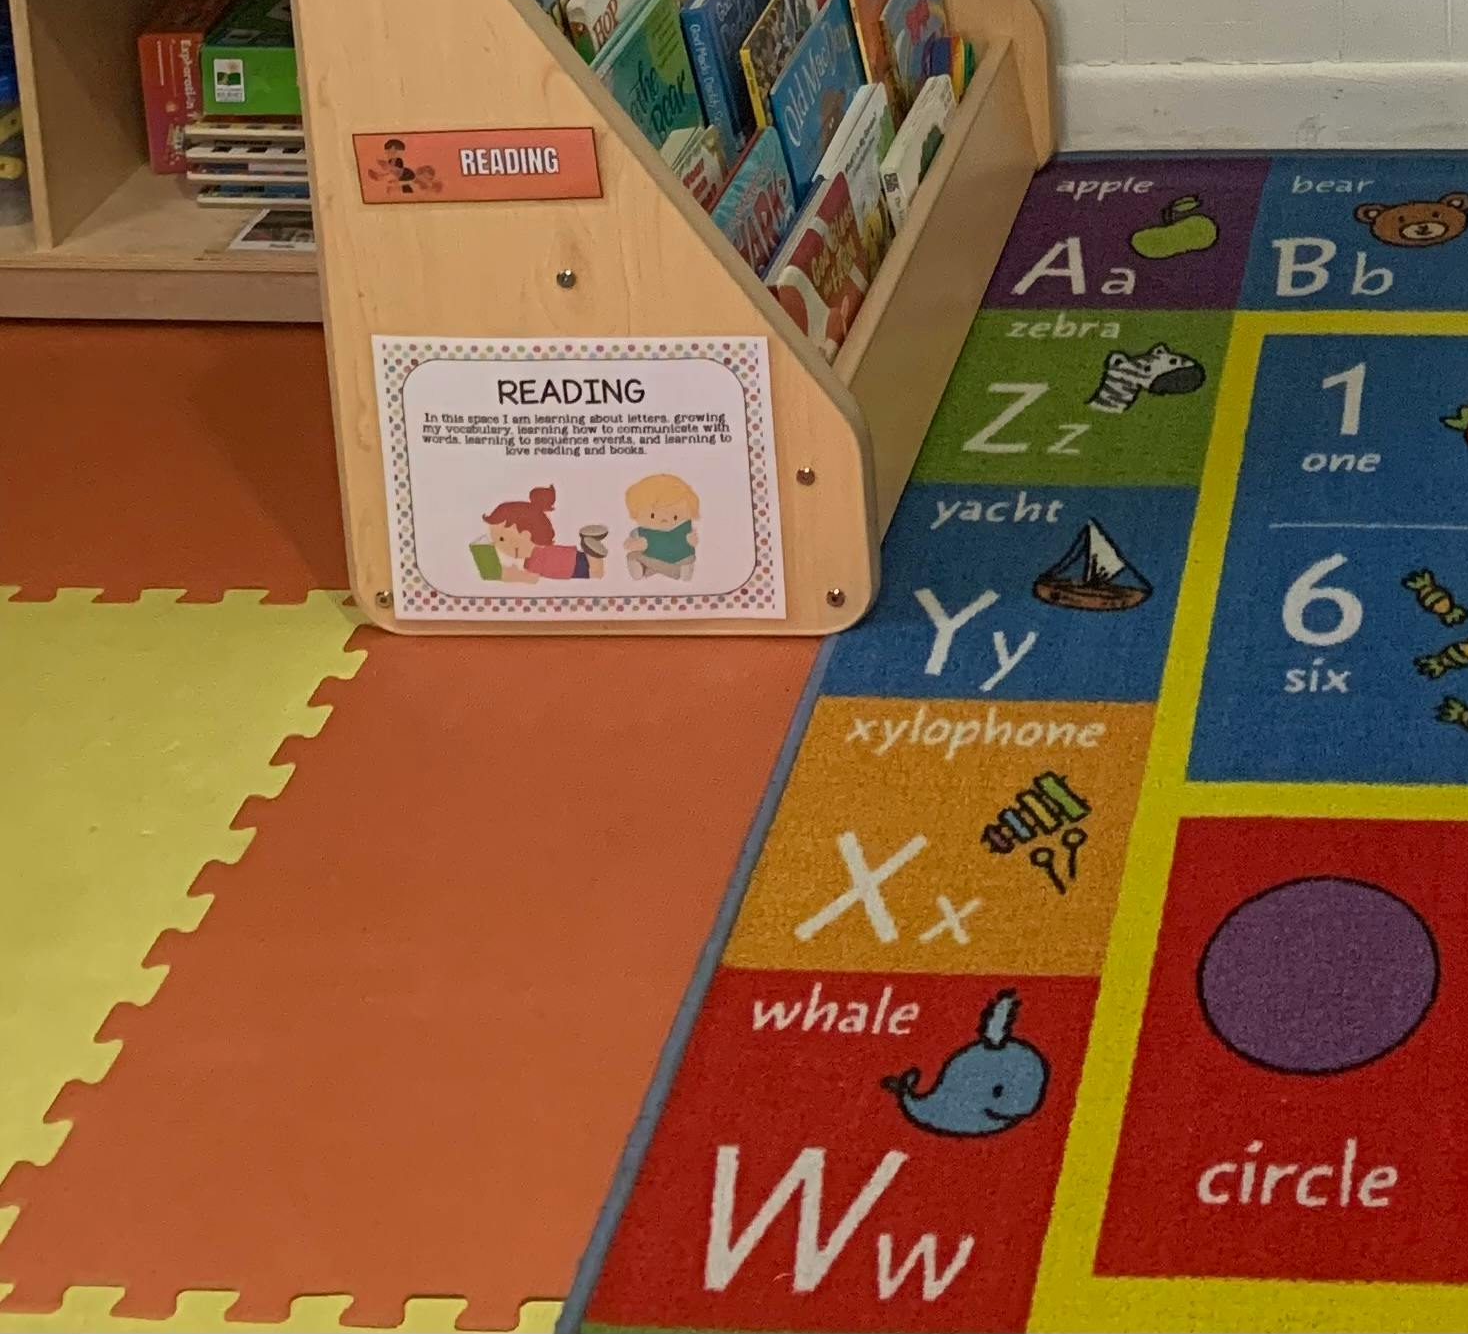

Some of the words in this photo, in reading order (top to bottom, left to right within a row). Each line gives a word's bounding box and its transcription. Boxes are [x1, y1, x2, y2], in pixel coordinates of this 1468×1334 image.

[460, 147, 560, 176] READING
[1054, 174, 1153, 199] apple
[1292, 172, 1375, 195] bear
[1012, 238, 1136, 298] Aa
[1008, 314, 1121, 340] zebra
[498, 379, 645, 405] READING
[506, 446, 530, 455] love
[534, 446, 580, 456] reading
[584, 446, 605, 455] and
[1302, 449, 1382, 474] one
[931, 492, 1062, 530] yacht
[846, 707, 1107, 759] xylophone
[752, 983, 920, 1036] whale
[1196, 1142, 1398, 1210] circle
